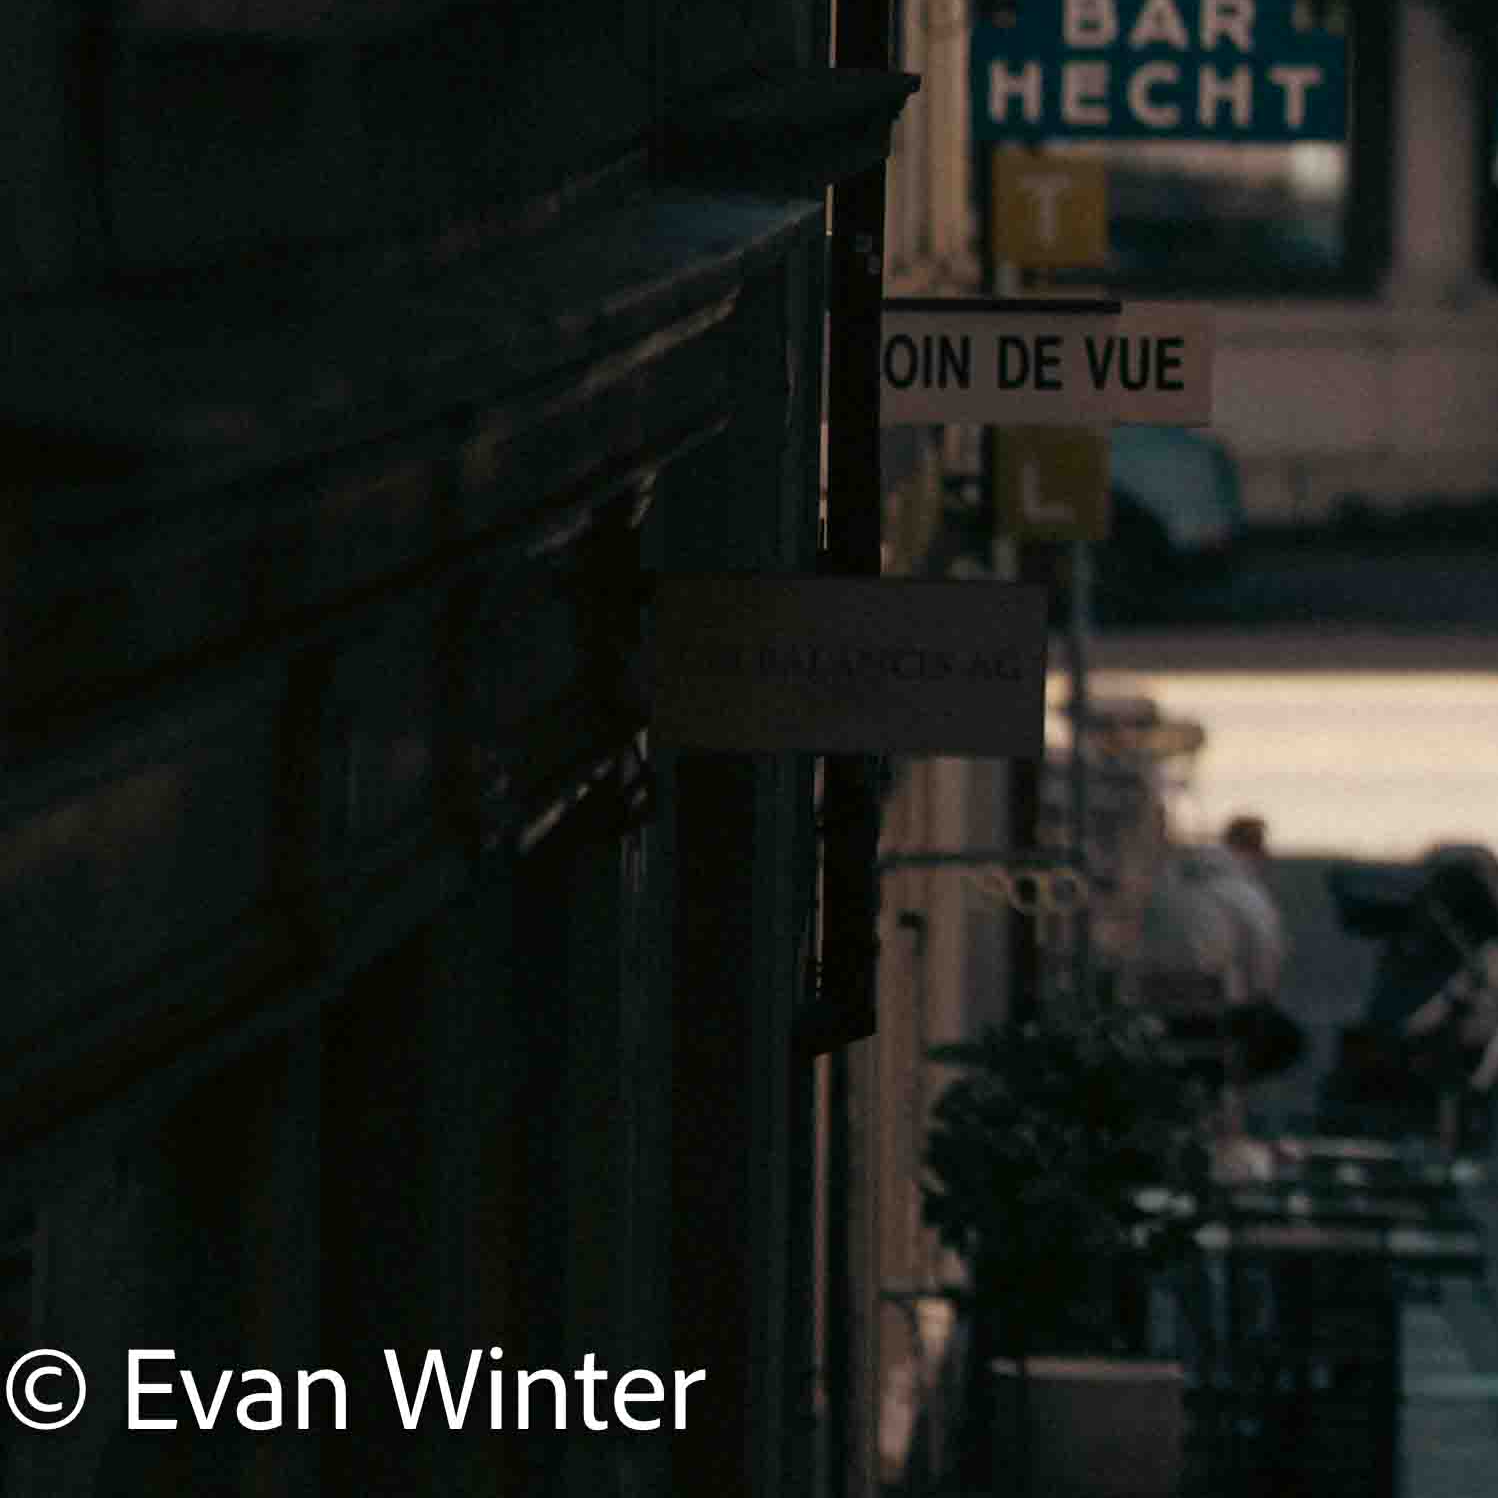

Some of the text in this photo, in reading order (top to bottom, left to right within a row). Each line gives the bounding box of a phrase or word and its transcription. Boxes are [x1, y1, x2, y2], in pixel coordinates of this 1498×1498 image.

[985, 59, 1322, 128] HECHT
[884, 332, 1185, 393] OIN DE VUE
